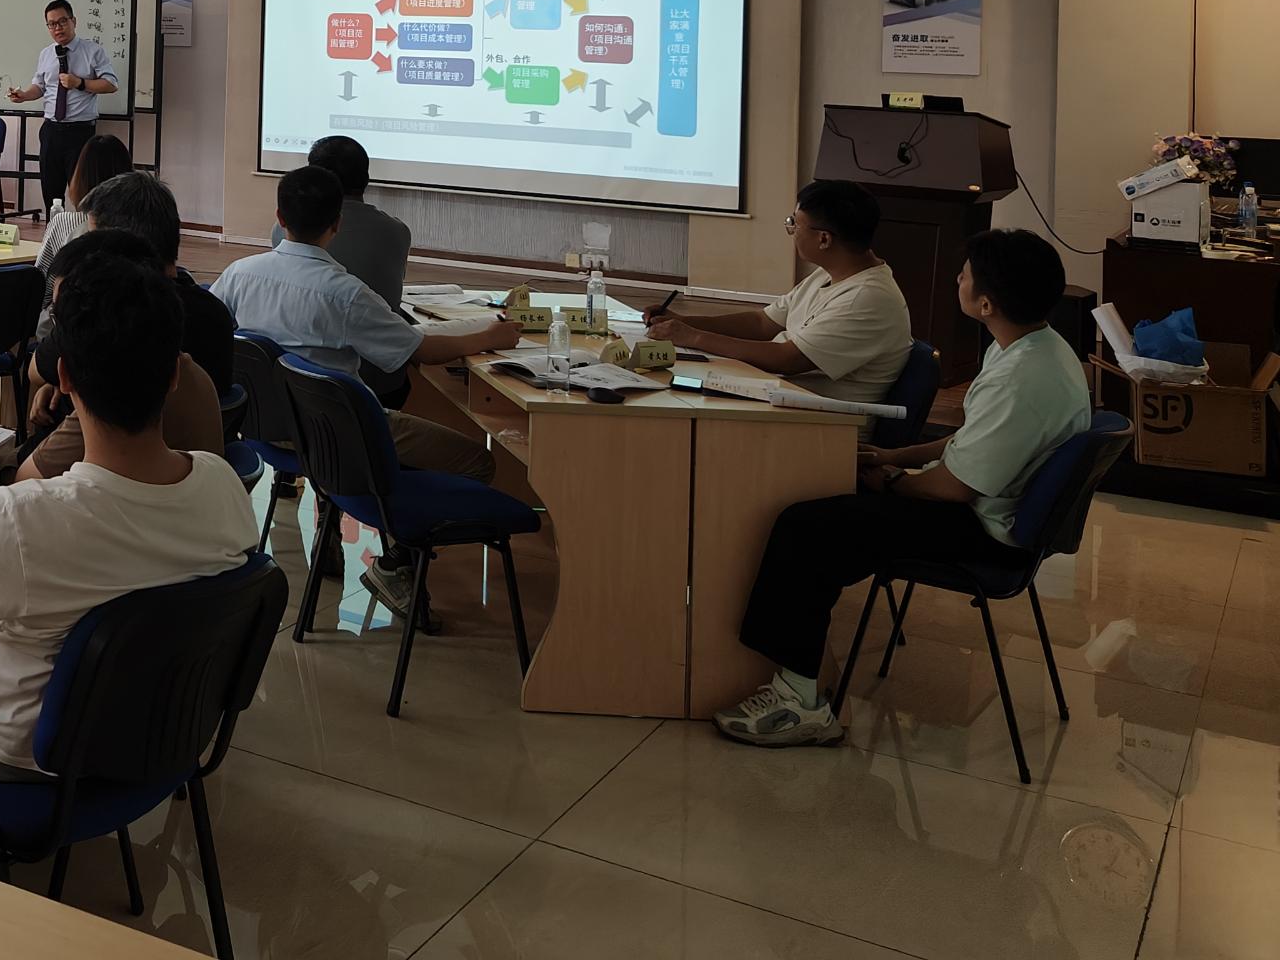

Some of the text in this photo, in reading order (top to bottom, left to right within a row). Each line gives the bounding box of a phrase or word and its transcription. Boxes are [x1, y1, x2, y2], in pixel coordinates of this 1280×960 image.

[670, 8, 690, 19] 让大
[891, 33, 929, 43] 奋发进取
[486, 54, 531, 64] 外包、合作
[1143, 393, 1181, 420] SF
